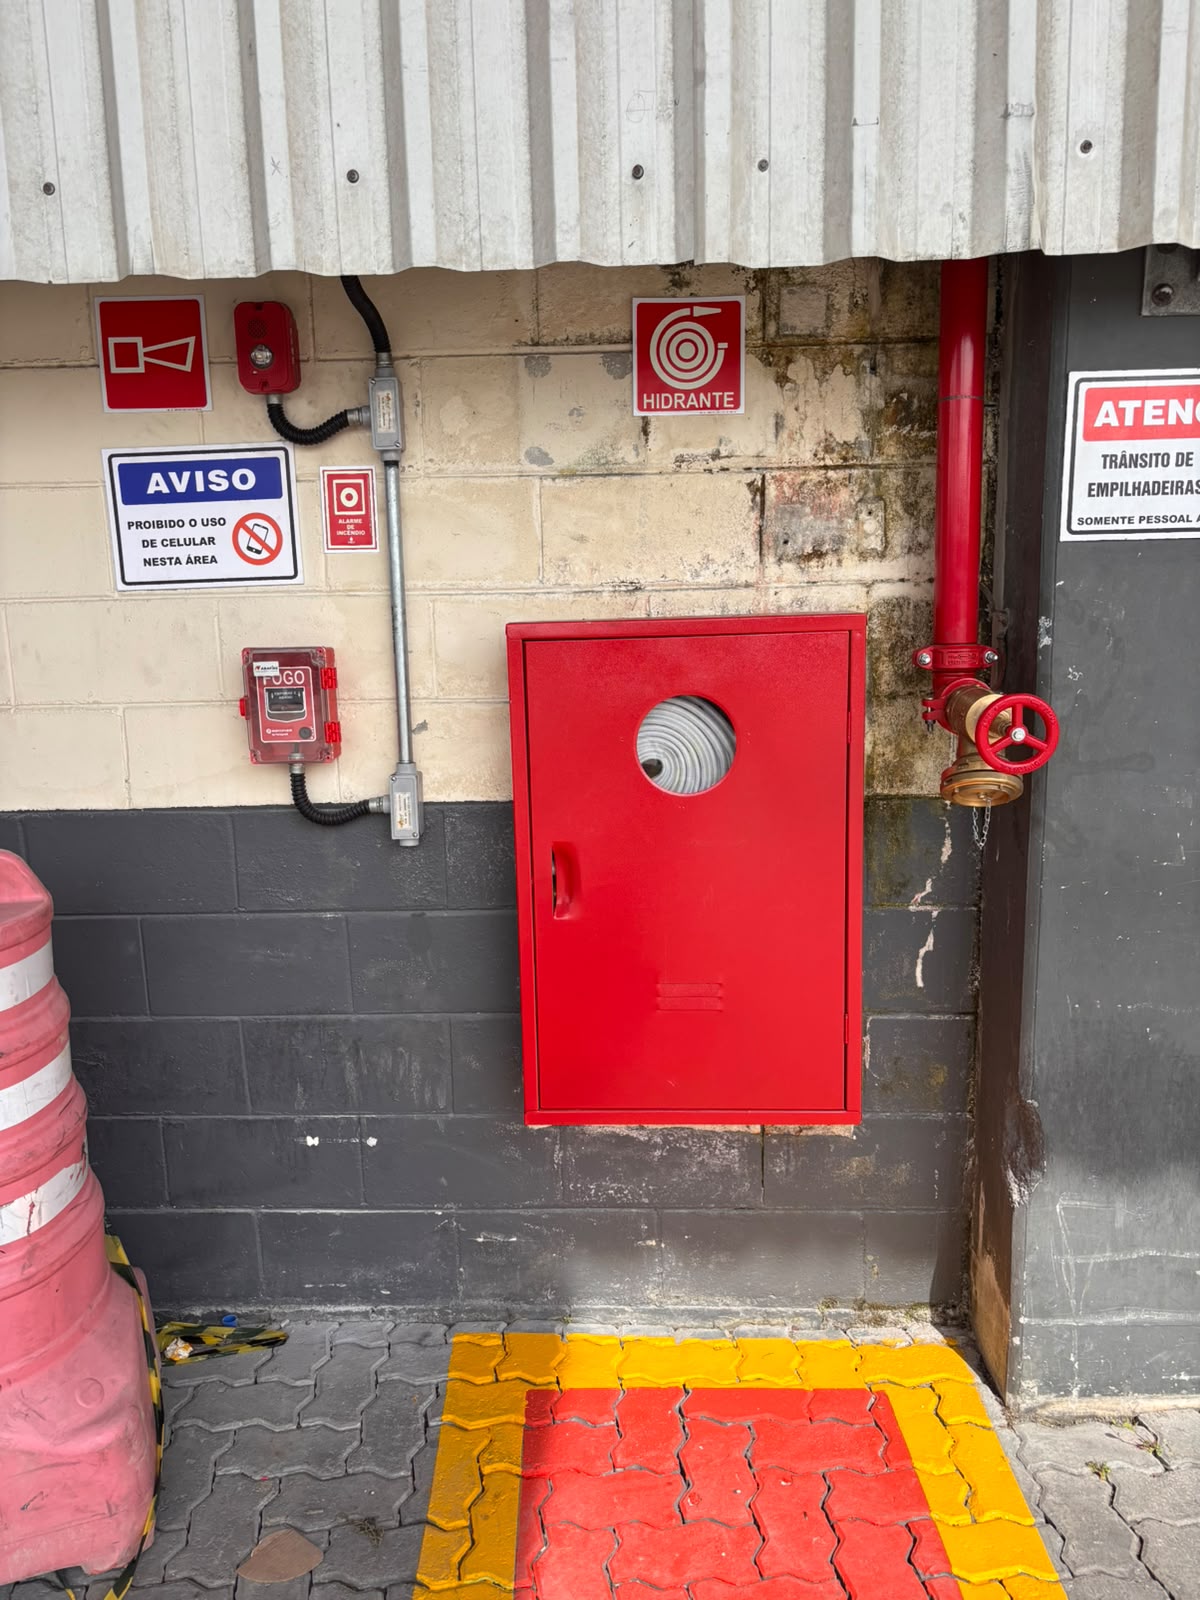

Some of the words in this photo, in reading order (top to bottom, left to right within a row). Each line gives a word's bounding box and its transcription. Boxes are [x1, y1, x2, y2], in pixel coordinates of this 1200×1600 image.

[643, 392, 735, 409] HIDRANTE
[1093, 398, 1200, 427] ATEN
[1101, 450, 1171, 469] TRÂNSITO
[1175, 451, 1194, 467] DE
[146, 468, 256, 494] AVISO
[127, 519, 185, 530] PROIBIDO
[188, 518, 198, 528] O
[200, 517, 226, 527] USO
[1077, 516, 1135, 526] SOMENTE
[1138, 515, 1193, 525] PESSOAL
[142, 539, 158, 548] DE
[161, 537, 216, 547] CELULAR
[143, 557, 182, 567] NESTA
[185, 554, 218, 565] ÁREA
[263, 670, 305, 685] FOGO
